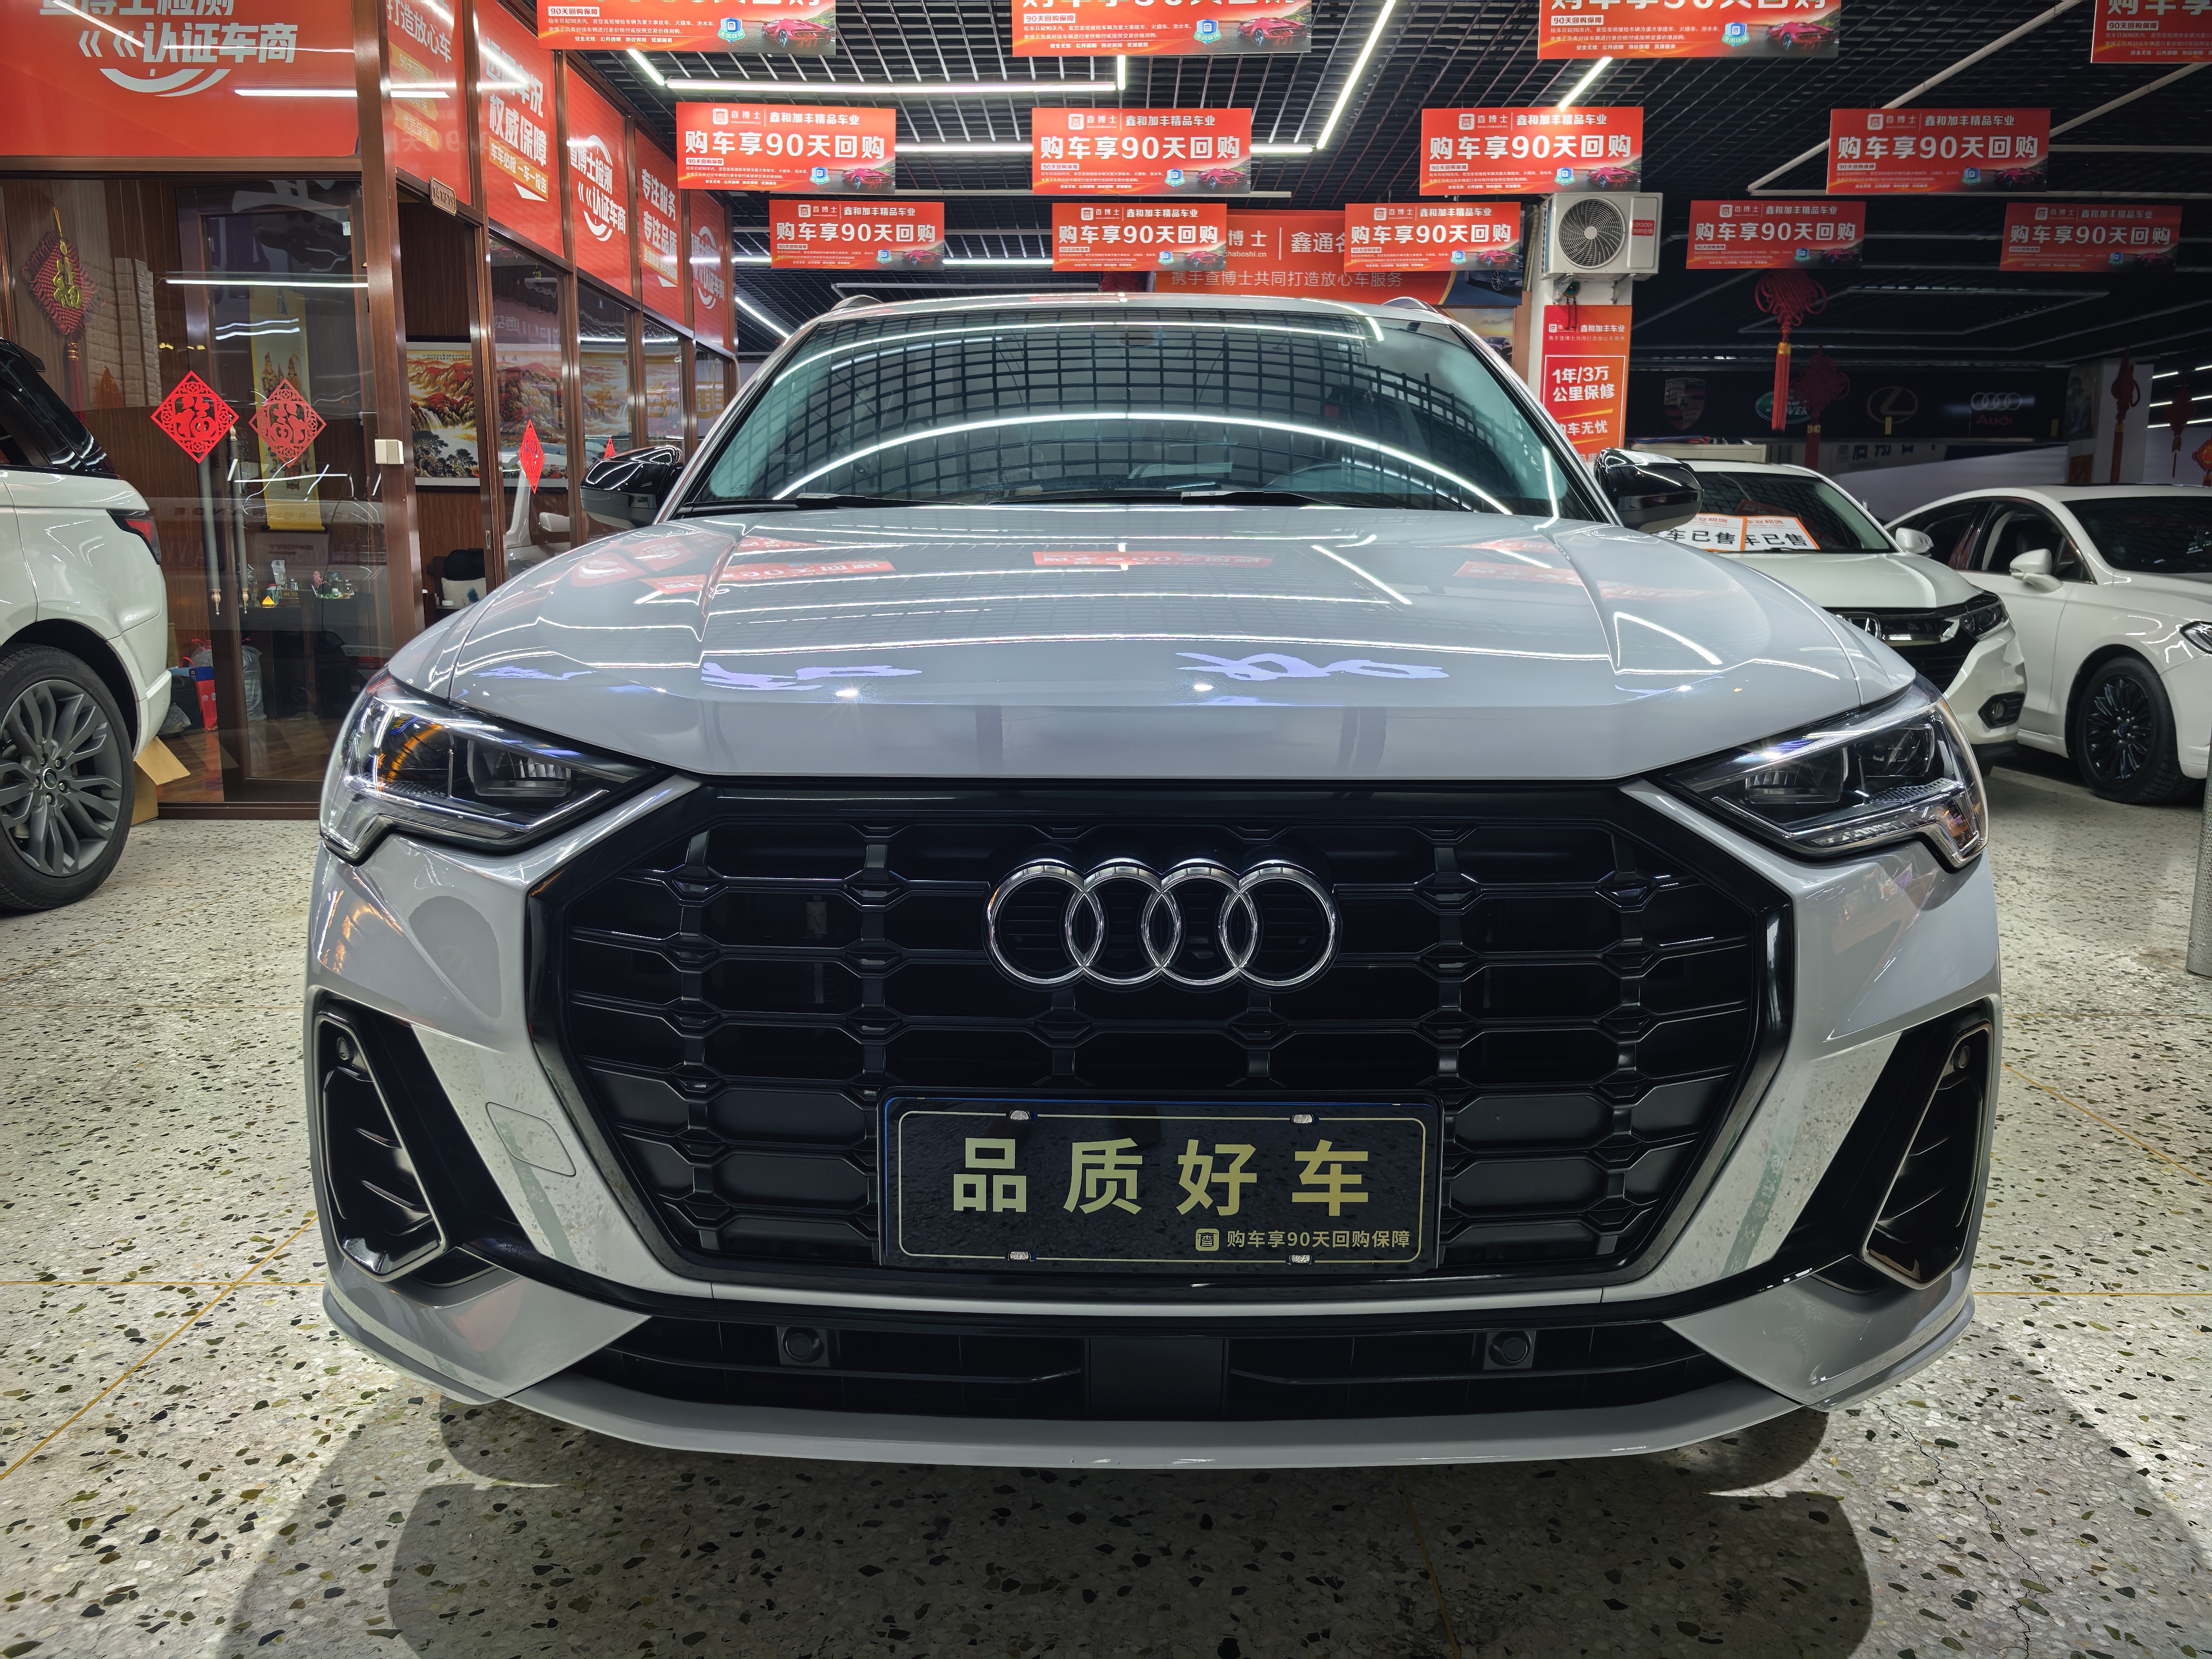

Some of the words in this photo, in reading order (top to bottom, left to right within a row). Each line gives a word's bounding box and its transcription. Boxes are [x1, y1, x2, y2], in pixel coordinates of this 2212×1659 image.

[387, 0, 451, 63] 打造放心车
[143, 23, 298, 63] 认证车商
[770, 111, 860, 125] 鑫和加丰精品车业
[1125, 115, 1216, 126] 鑫和加丰精品车业
[1516, 114, 1607, 126] 鑫和加丰精品车业
[1925, 115, 2014, 126] 鑫和加丰精品车业
[489, 93, 547, 167] 权威保障
[685, 131, 885, 159] 购车享90天回购
[1041, 136, 1240, 159] 购车享90天回购
[1429, 135, 1631, 160] 购车享90天回购
[1837, 136, 2038, 159] 购车享90天回购
[570, 146, 612, 194] 查博士检测
[642, 168, 676, 221] 专注服务
[593, 186, 626, 234] 认证车商
[844, 207, 915, 216] 鑫和加丰精品车业
[1127, 209, 1198, 217] 鑫和加丰精品车业
[1420, 208, 1492, 217] 鑫和加丰精品车业
[644, 211, 677, 259] 专注品质
[776, 222, 935, 242] 购车享90天回购
[1059, 225, 1218, 244] 购车享90天回购
[1351, 224, 1511, 244] 购车享90天回购
[1695, 222, 1856, 241] 购车享90天回购
[2009, 225, 2171, 245] 购车享90天回购
[1171, 271, 1402, 287] 携手查博士共同打造放心车服务
[1552, 366, 1609, 384] 1年/3万
[1553, 383, 1615, 402] 公里保修
[953, 1136, 1371, 1217] 品质好车
[1227, 1230, 1410, 1248] 购车享90天回购保障
